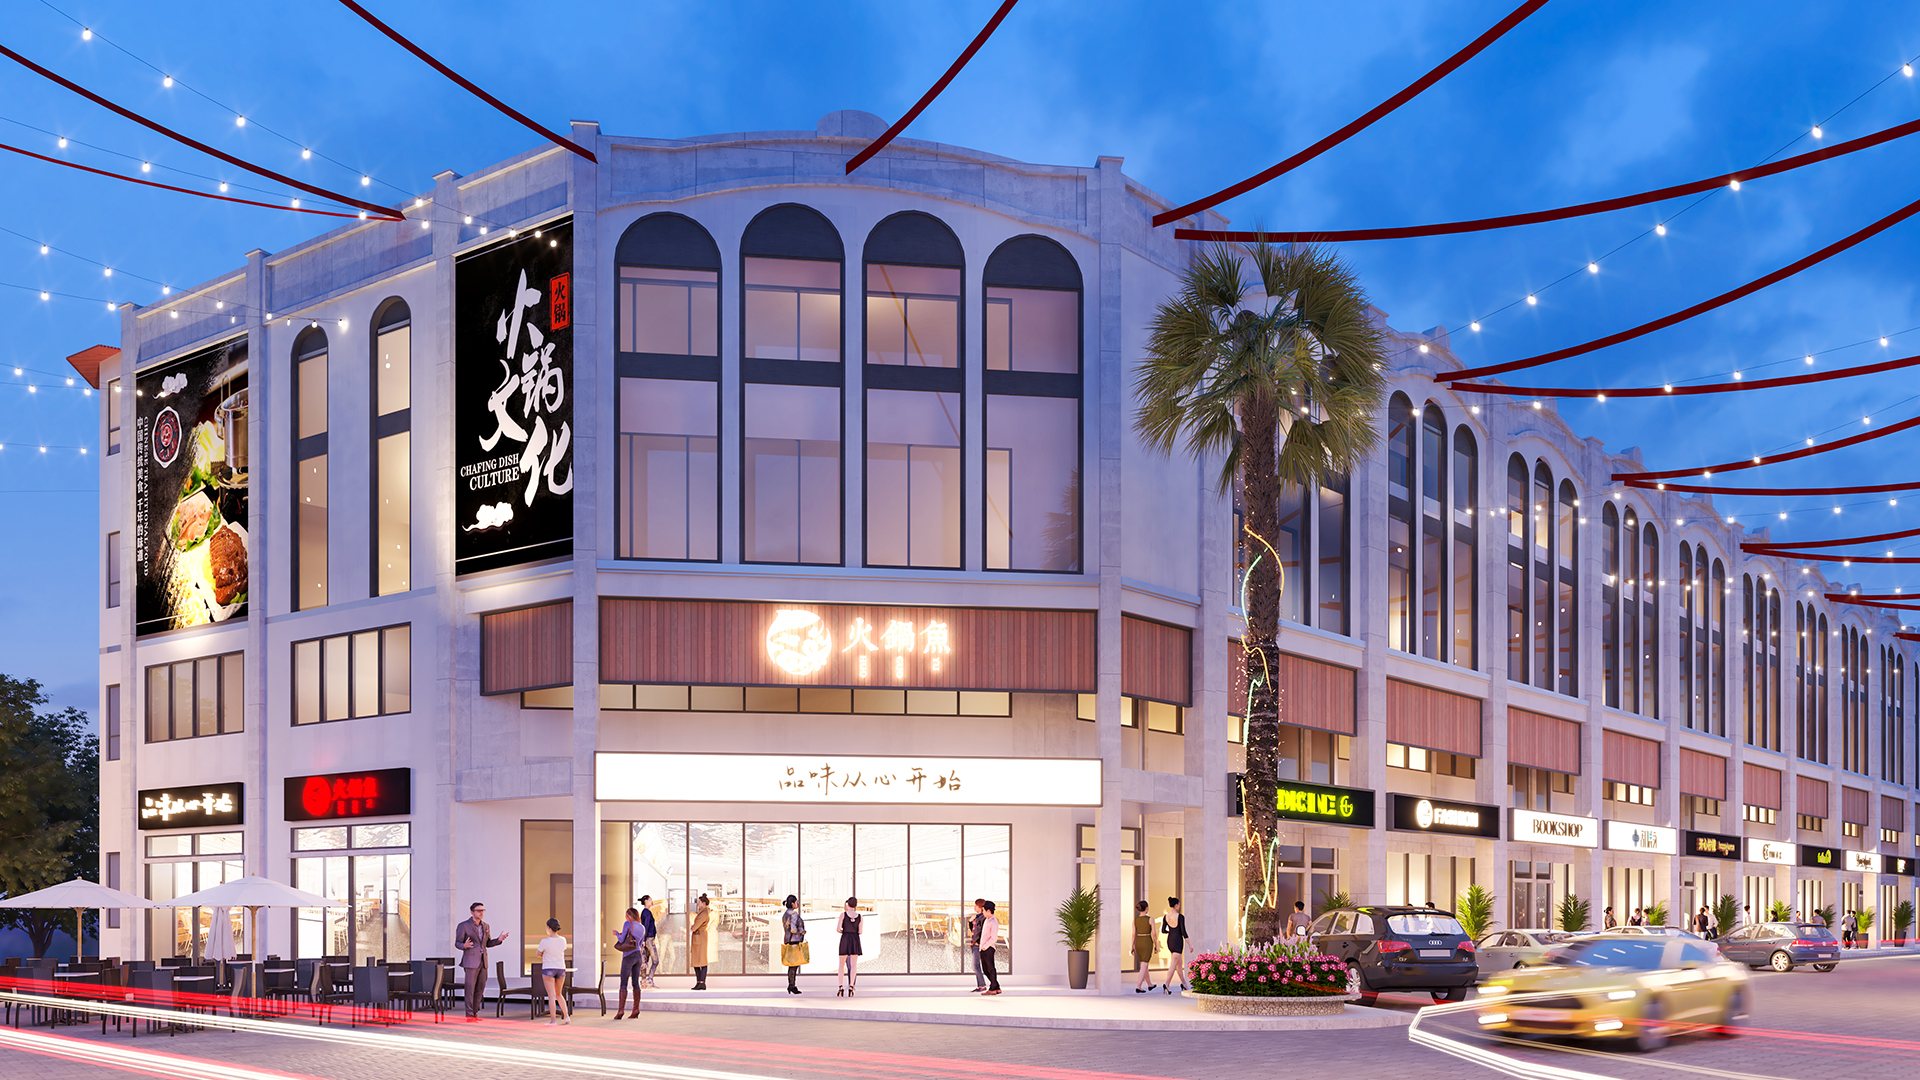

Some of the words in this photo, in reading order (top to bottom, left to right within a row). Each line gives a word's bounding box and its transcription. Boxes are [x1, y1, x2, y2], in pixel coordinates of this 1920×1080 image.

[552, 281, 567, 324] 火锅
[479, 268, 574, 508] 火锅文化
[460, 459, 497, 478] CHAFING
[498, 453, 520, 471] DISH
[469, 469, 520, 491] CULTURE
[858, 655, 868, 679] HUO
[895, 655, 904, 679] GUO
[778, 761, 964, 797] 品味从心开始
[1533, 819, 1583, 838] BOOKSHOP
